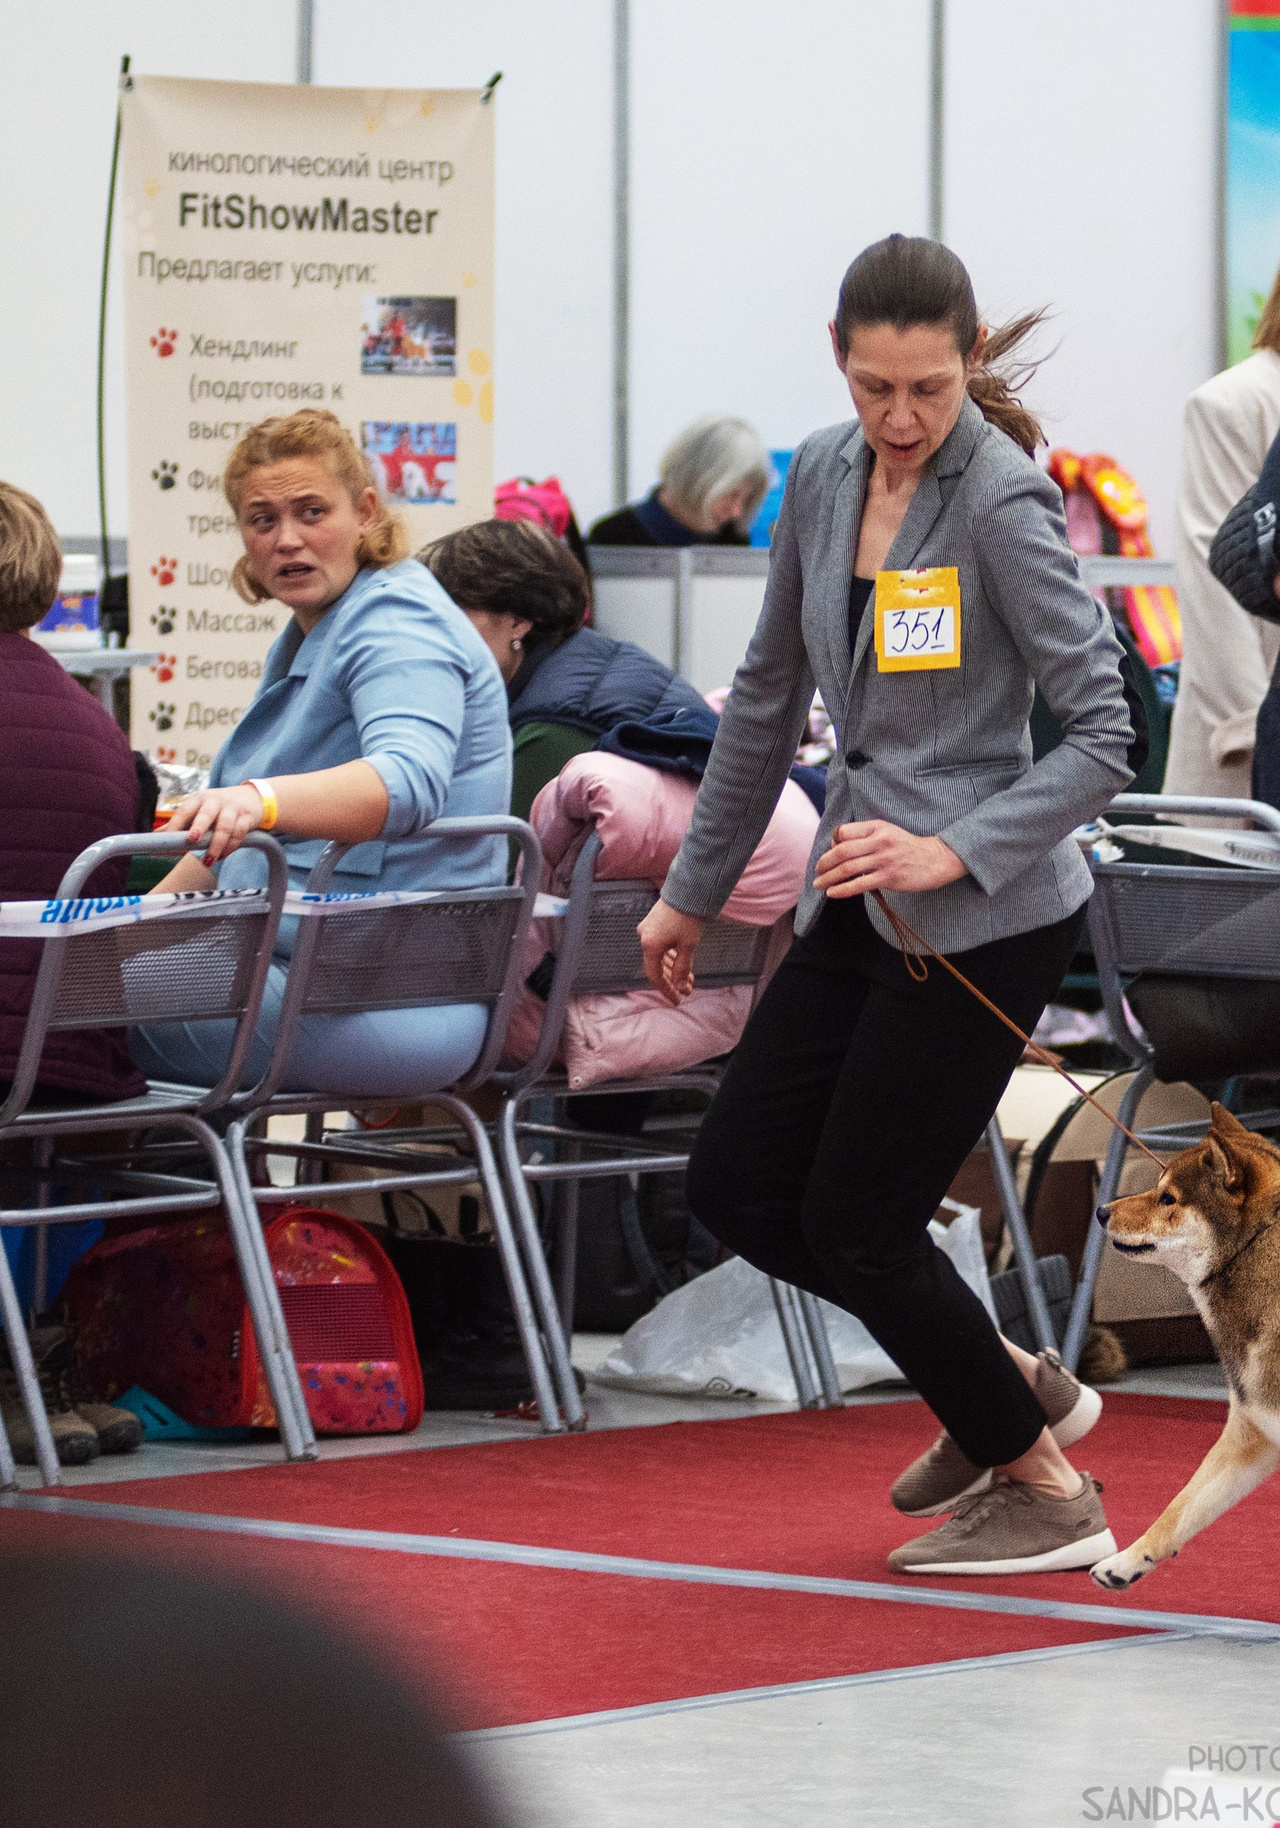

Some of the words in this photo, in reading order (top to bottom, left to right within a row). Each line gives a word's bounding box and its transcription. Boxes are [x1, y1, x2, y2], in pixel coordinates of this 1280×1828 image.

[168, 150, 371, 179] кинологический
[378, 158, 454, 186] центр
[179, 193, 439, 235] FitShowMaster
[138, 251, 284, 285] Предлагает
[291, 261, 378, 289] услуги:
[190, 335, 298, 362] Хендлинг
[188, 373, 324, 401] (подготовка
[332, 384, 344, 400] к
[188, 420, 254, 440] выст
[187, 469, 222, 491] Фи
[188, 515, 240, 538] трен
[186, 609, 276, 633] Массаж
[891, 607, 945, 653] 351
[186, 653, 262, 680] Бегова
[183, 701, 242, 730] Дрес
